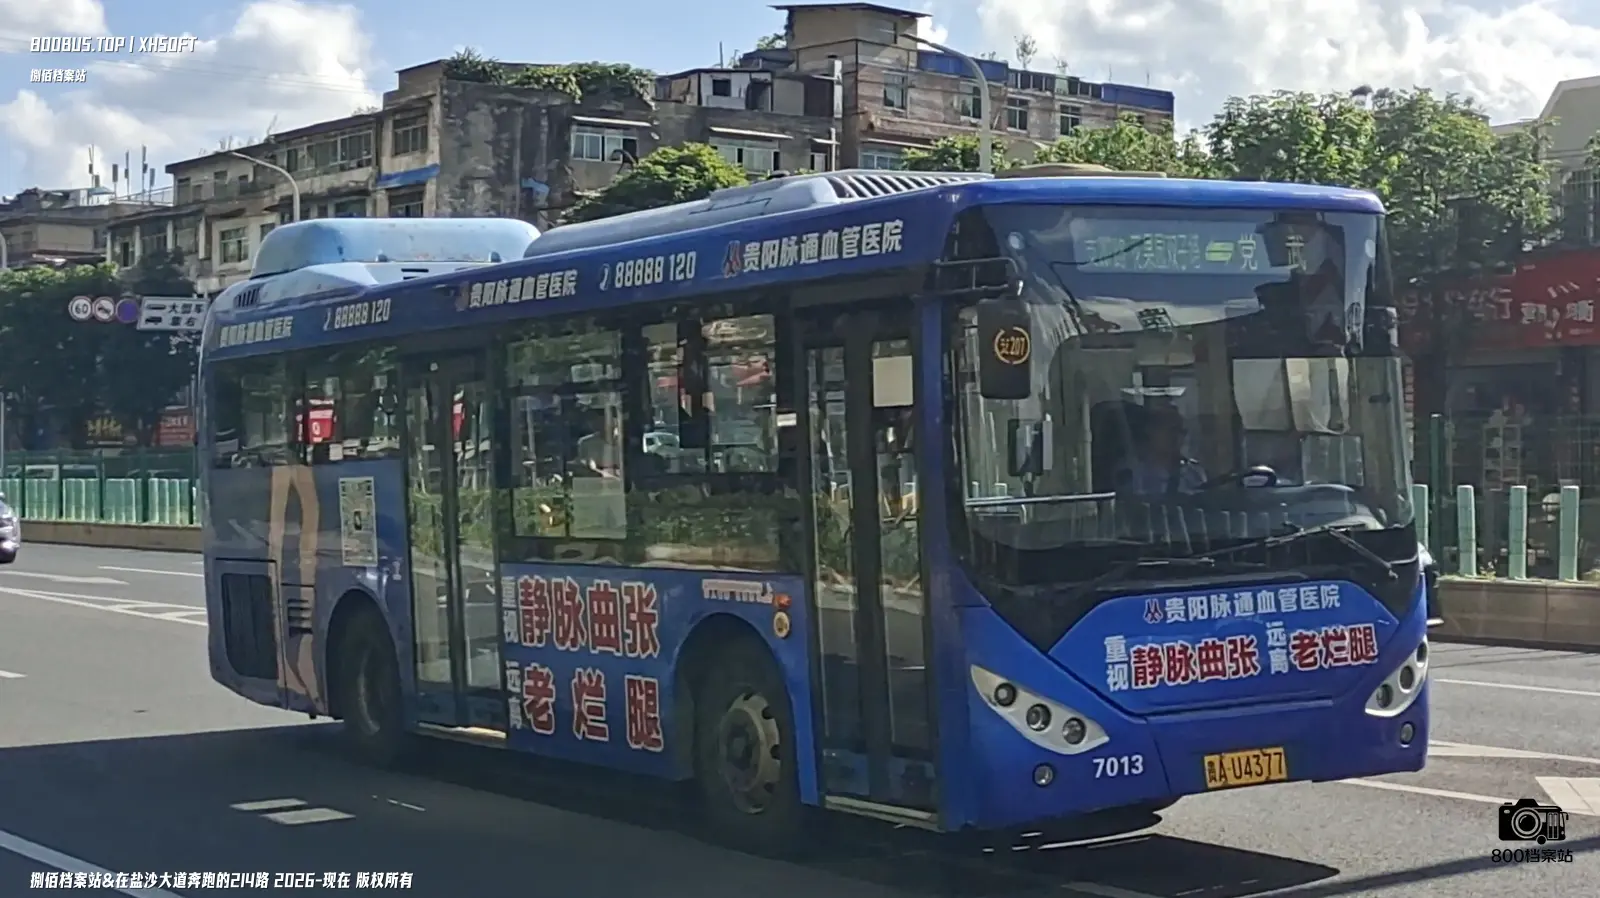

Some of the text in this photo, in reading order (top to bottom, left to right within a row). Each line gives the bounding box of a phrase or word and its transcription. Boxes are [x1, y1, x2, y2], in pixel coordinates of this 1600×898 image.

[614, 251, 697, 289] 88888 120
[742, 219, 904, 273] 贵阳脉通血管医院
[75, 303, 89, 315] 60
[334, 298, 391, 330] 88888 120
[518, 575, 661, 659] 静脉曲张
[1165, 584, 1341, 624] 贵阳脉通血管医院
[1104, 635, 1129, 692] 重视
[1130, 635, 1261, 690] 静脉曲张
[1289, 623, 1379, 671] 老烂腿
[523, 662, 664, 752] 老烂腿
[1092, 754, 1145, 779] 7013
